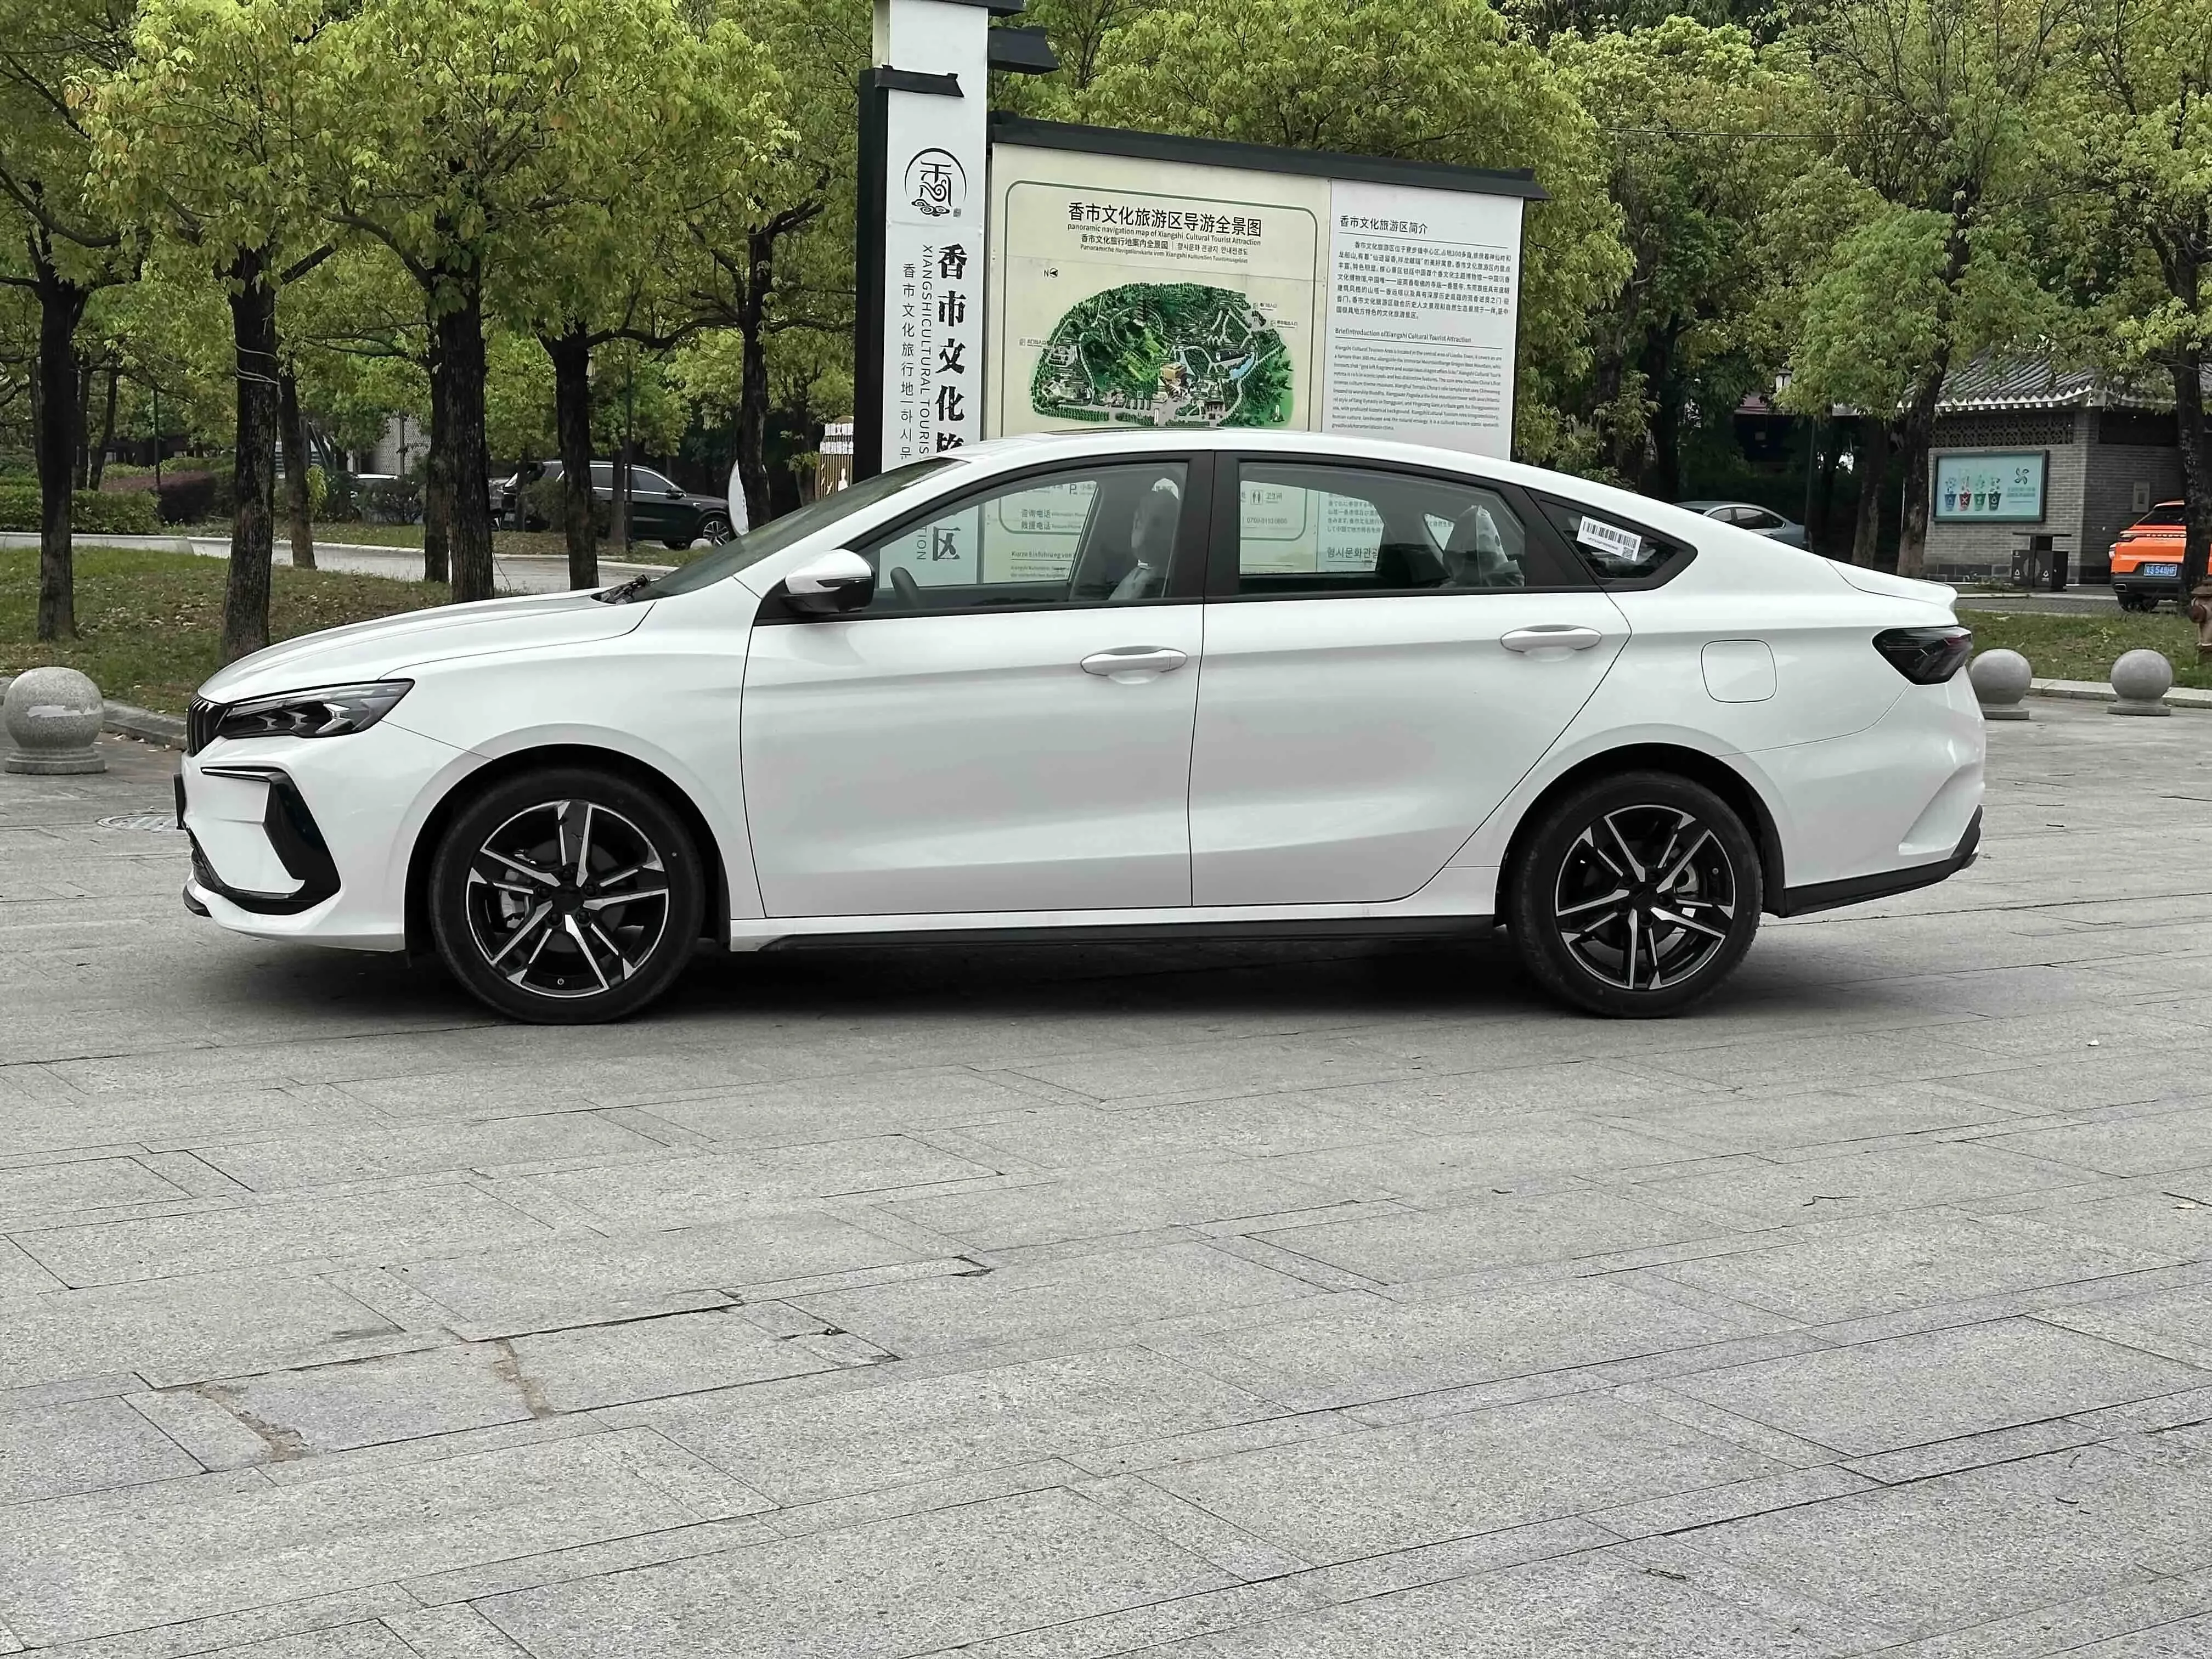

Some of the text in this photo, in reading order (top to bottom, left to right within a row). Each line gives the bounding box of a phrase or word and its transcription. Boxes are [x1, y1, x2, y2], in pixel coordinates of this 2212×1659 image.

[1069, 202, 1261, 238] 香市文化旅游区导游全景图
[1340, 215, 1427, 235] 香市文化旅游区简介
[1068, 224, 1101, 232] panoramic
[1102, 226, 1134, 235] navigation
[1135, 229, 1149, 238] map
[1158, 231, 1183, 240] Xiangshi
[1186, 233, 1210, 242] Cultural
[1232, 238, 1261, 246] Attraction
[919, 399, 930, 460] TOURIS
[1021, 509, 1051, 518] 咨询电话
[933, 526, 961, 561] 区
